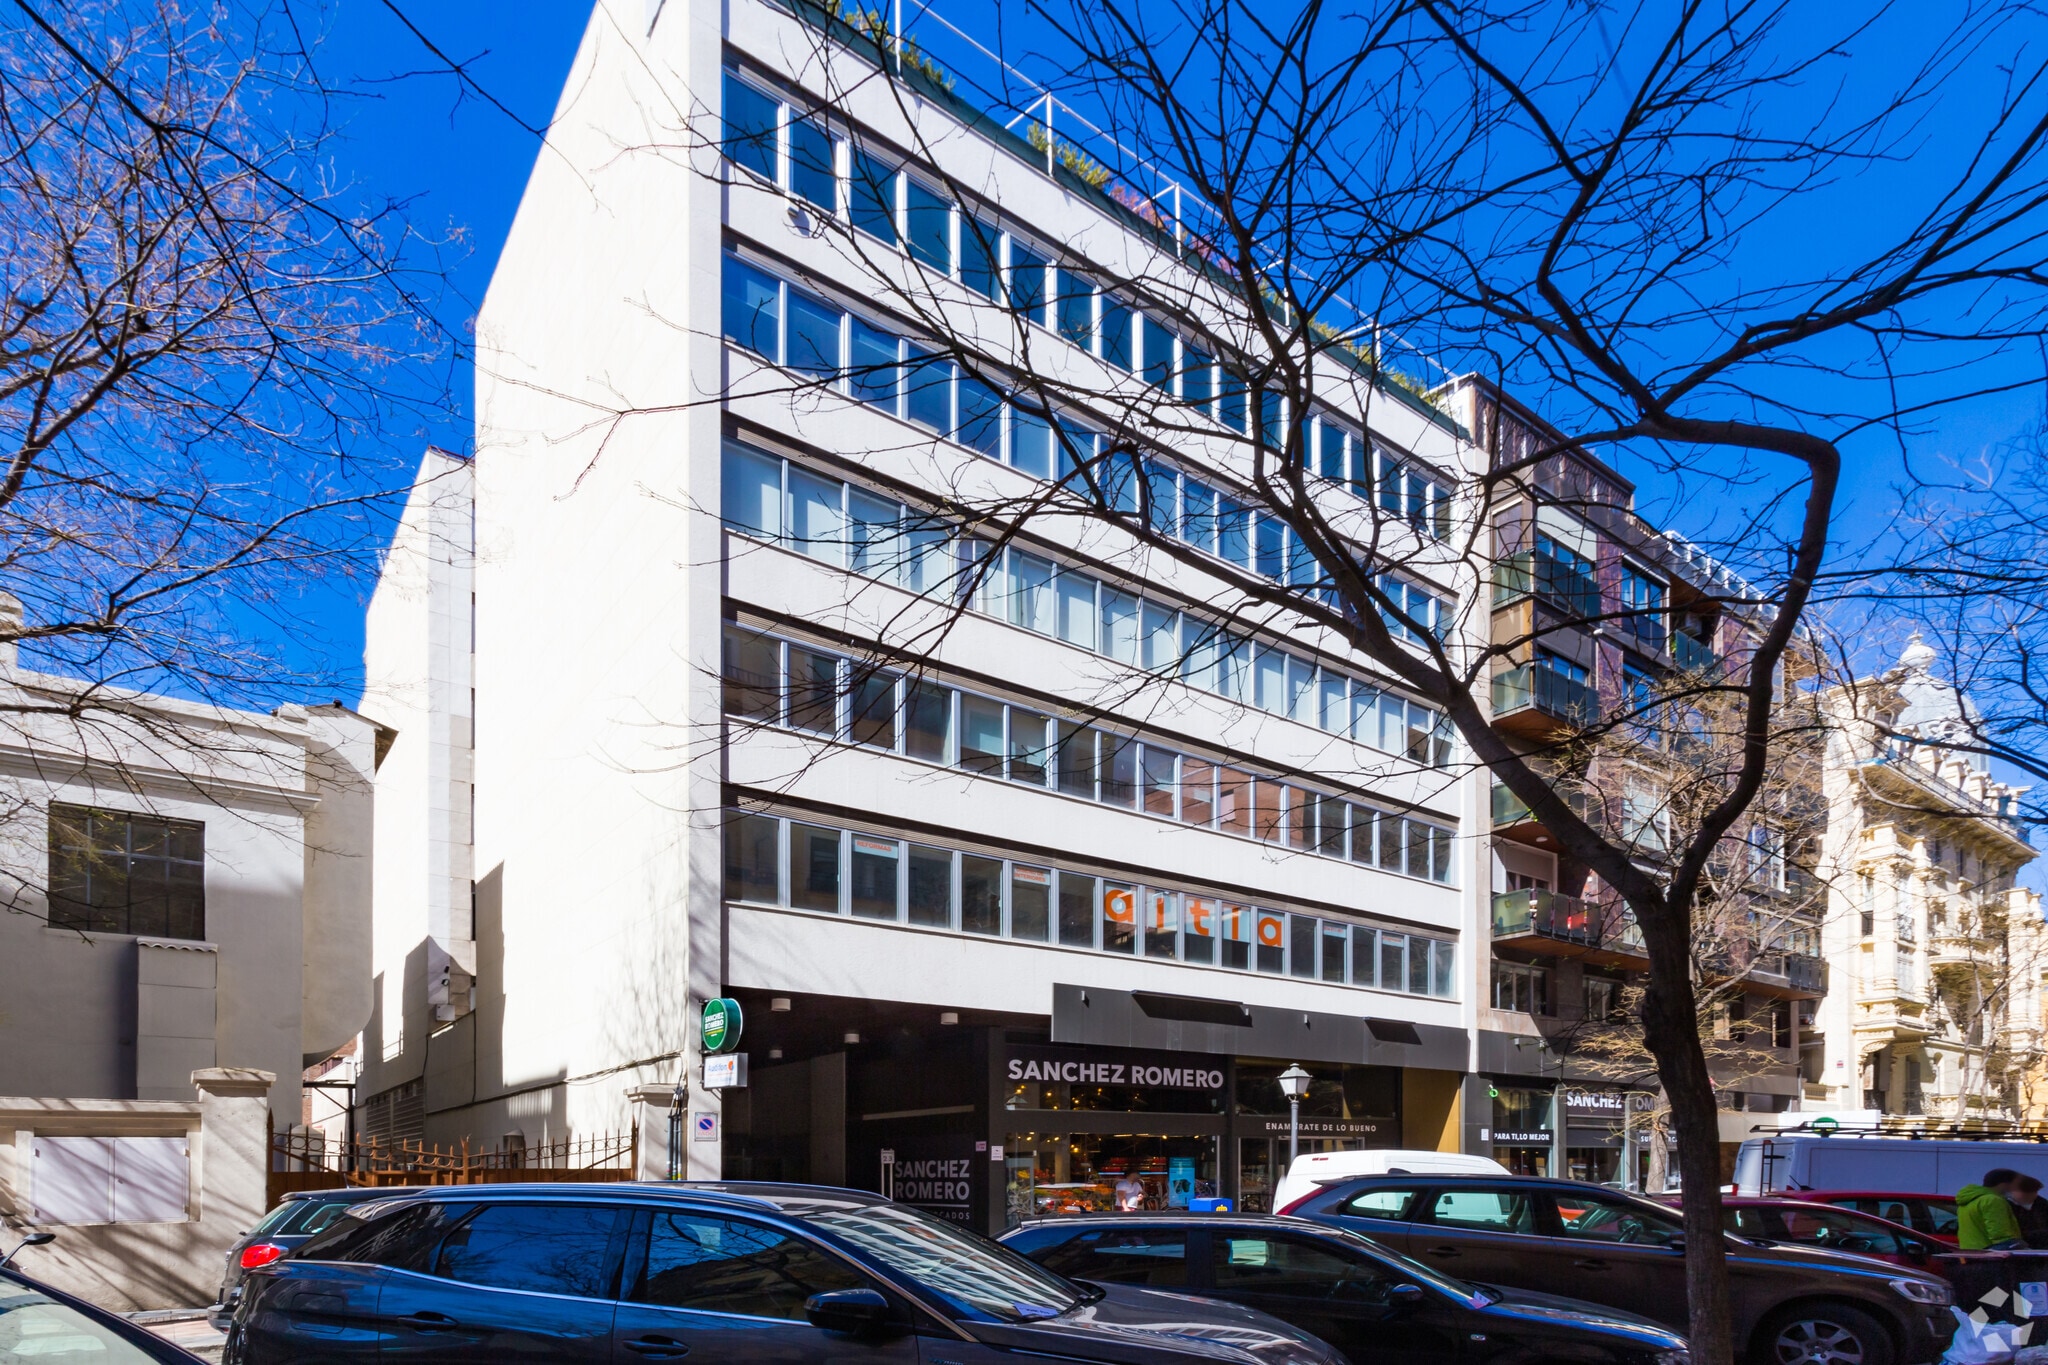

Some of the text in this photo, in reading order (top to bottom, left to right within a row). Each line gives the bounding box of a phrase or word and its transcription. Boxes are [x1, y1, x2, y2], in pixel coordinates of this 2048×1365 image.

[856, 840, 892, 852] REFORMAS
[704, 1012, 725, 1023] SANCHEZ
[704, 1019, 725, 1030] ROMERO
[1008, 1059, 1224, 1089] SANCHEZ ROMERO
[1566, 1091, 1623, 1109] SANCHEZ
[1265, 1122, 1320, 1131] ENAMRATE
[1336, 1124, 1347, 1132] LO
[1494, 1132, 1511, 1141] PARA
[1528, 1133, 1550, 1141] MEJOR
[894, 1160, 970, 1178] SANCHEZ
[895, 1181, 970, 1200] ROMERO
